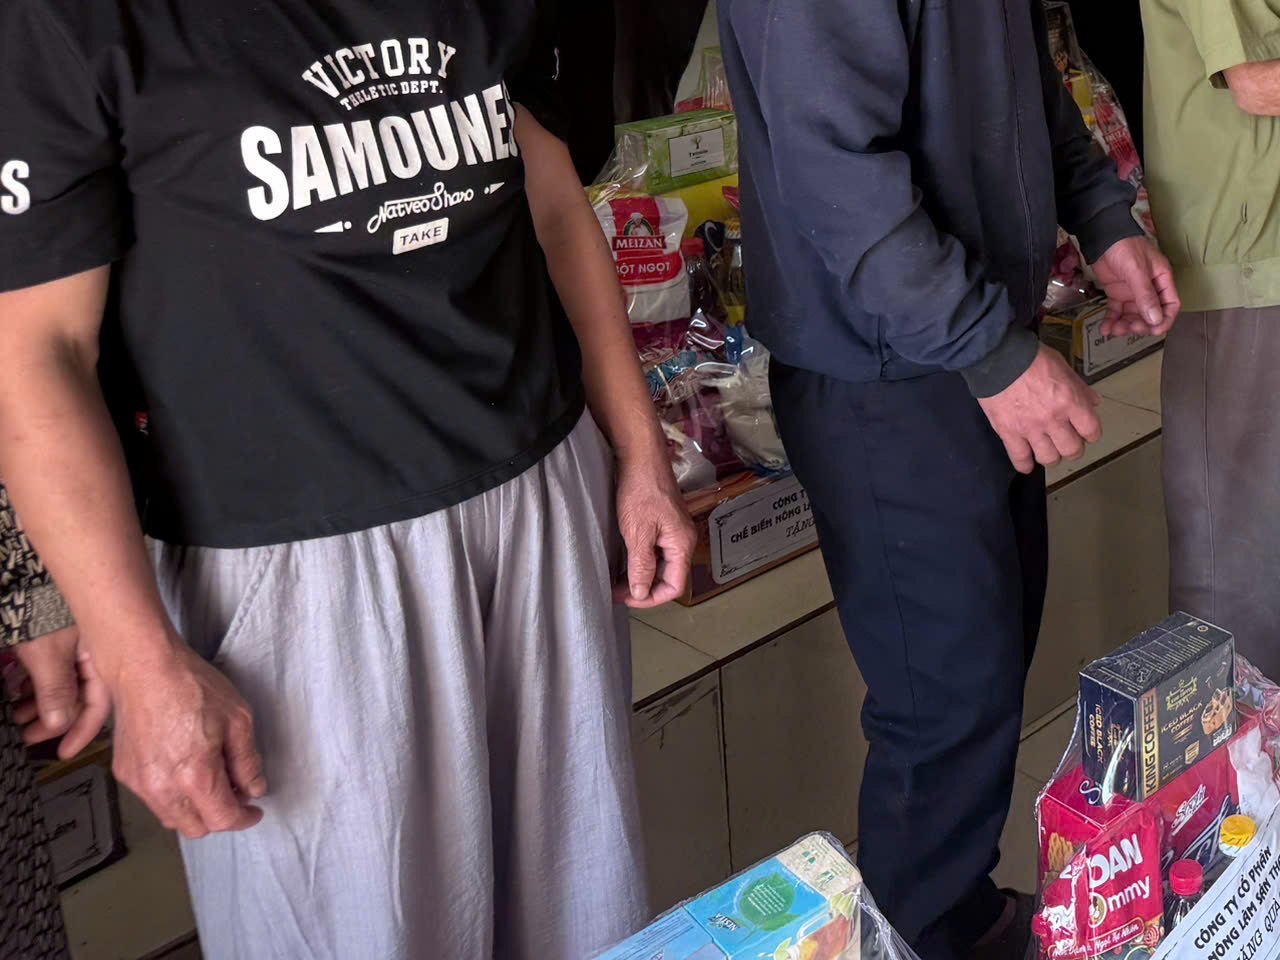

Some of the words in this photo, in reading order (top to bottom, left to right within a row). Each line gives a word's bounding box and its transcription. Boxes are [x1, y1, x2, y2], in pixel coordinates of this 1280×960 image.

[301, 37, 457, 99] VICTORY
[340, 83, 398, 111] THELETIC
[400, 80, 444, 95] DEPT.
[400, 225, 443, 246] TAKE
[616, 238, 662, 249] MEIZAN
[638, 261, 671, 275] NGỌT
[773, 492, 797, 510] CÔNG
[730, 524, 749, 543] CHẾ
[751, 516, 773, 536] BIẾN
[1142, 694, 1156, 754] COFFEE
[1143, 753, 1157, 793] KING
[1194, 912, 1226, 949] CÔNG
[1223, 895, 1240, 916] TY
[1237, 874, 1250, 899] CỔ
[1248, 845, 1272, 883] PHẦN
[1207, 927, 1240, 960] NÔNG
[1238, 901, 1257, 931] LÂM
[1256, 878, 1272, 905] SẢN
